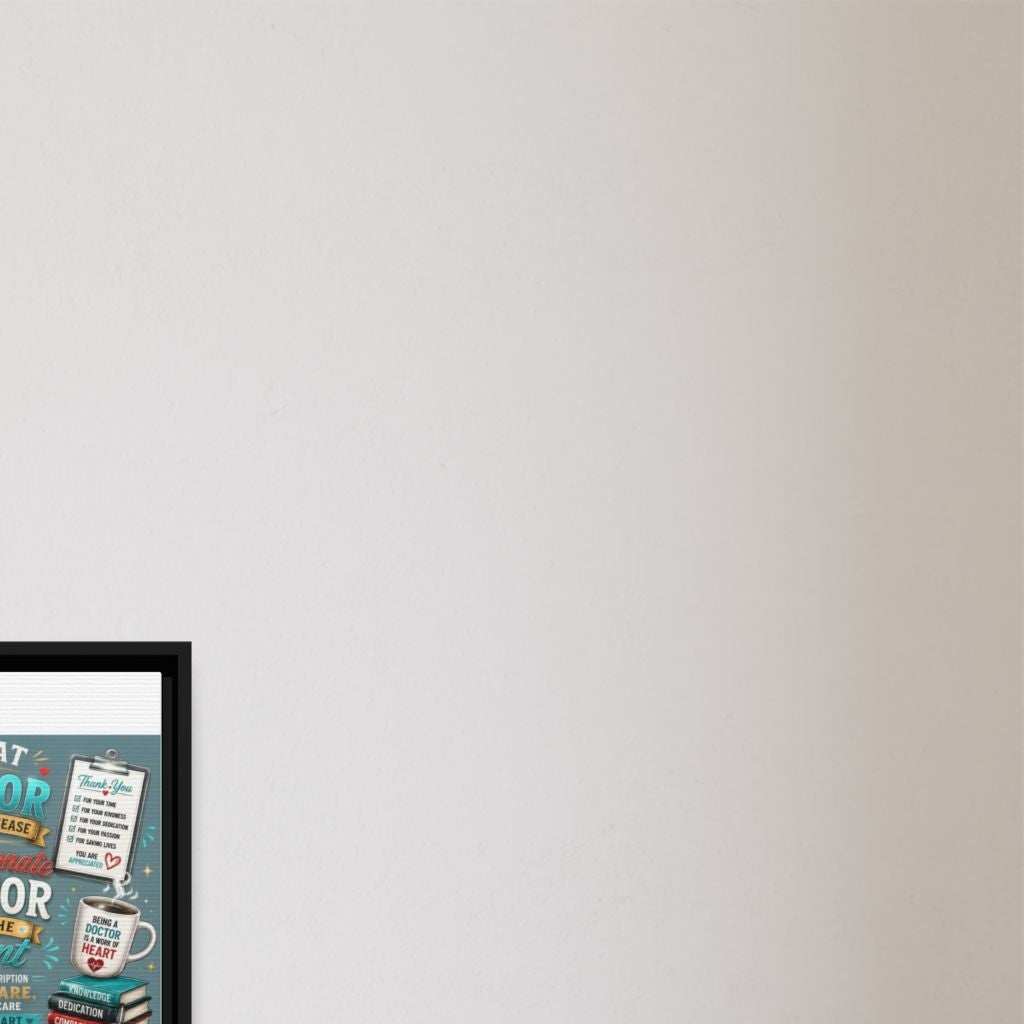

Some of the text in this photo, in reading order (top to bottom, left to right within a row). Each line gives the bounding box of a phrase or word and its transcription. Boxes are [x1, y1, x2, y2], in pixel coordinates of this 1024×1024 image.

[78, 774, 133, 796] Thank You
[103, 842, 116, 850] LIVES
[76, 850, 98, 860] YOU ARE
[92, 916, 118, 928] BEING A
[85, 924, 122, 940] DOCTOR
[96, 937, 111, 946] WORK
[82, 942, 118, 960] HEART
[68, 985, 112, 1003] KNOWLEDGE
[58, 1000, 104, 1019] DEDICATION
